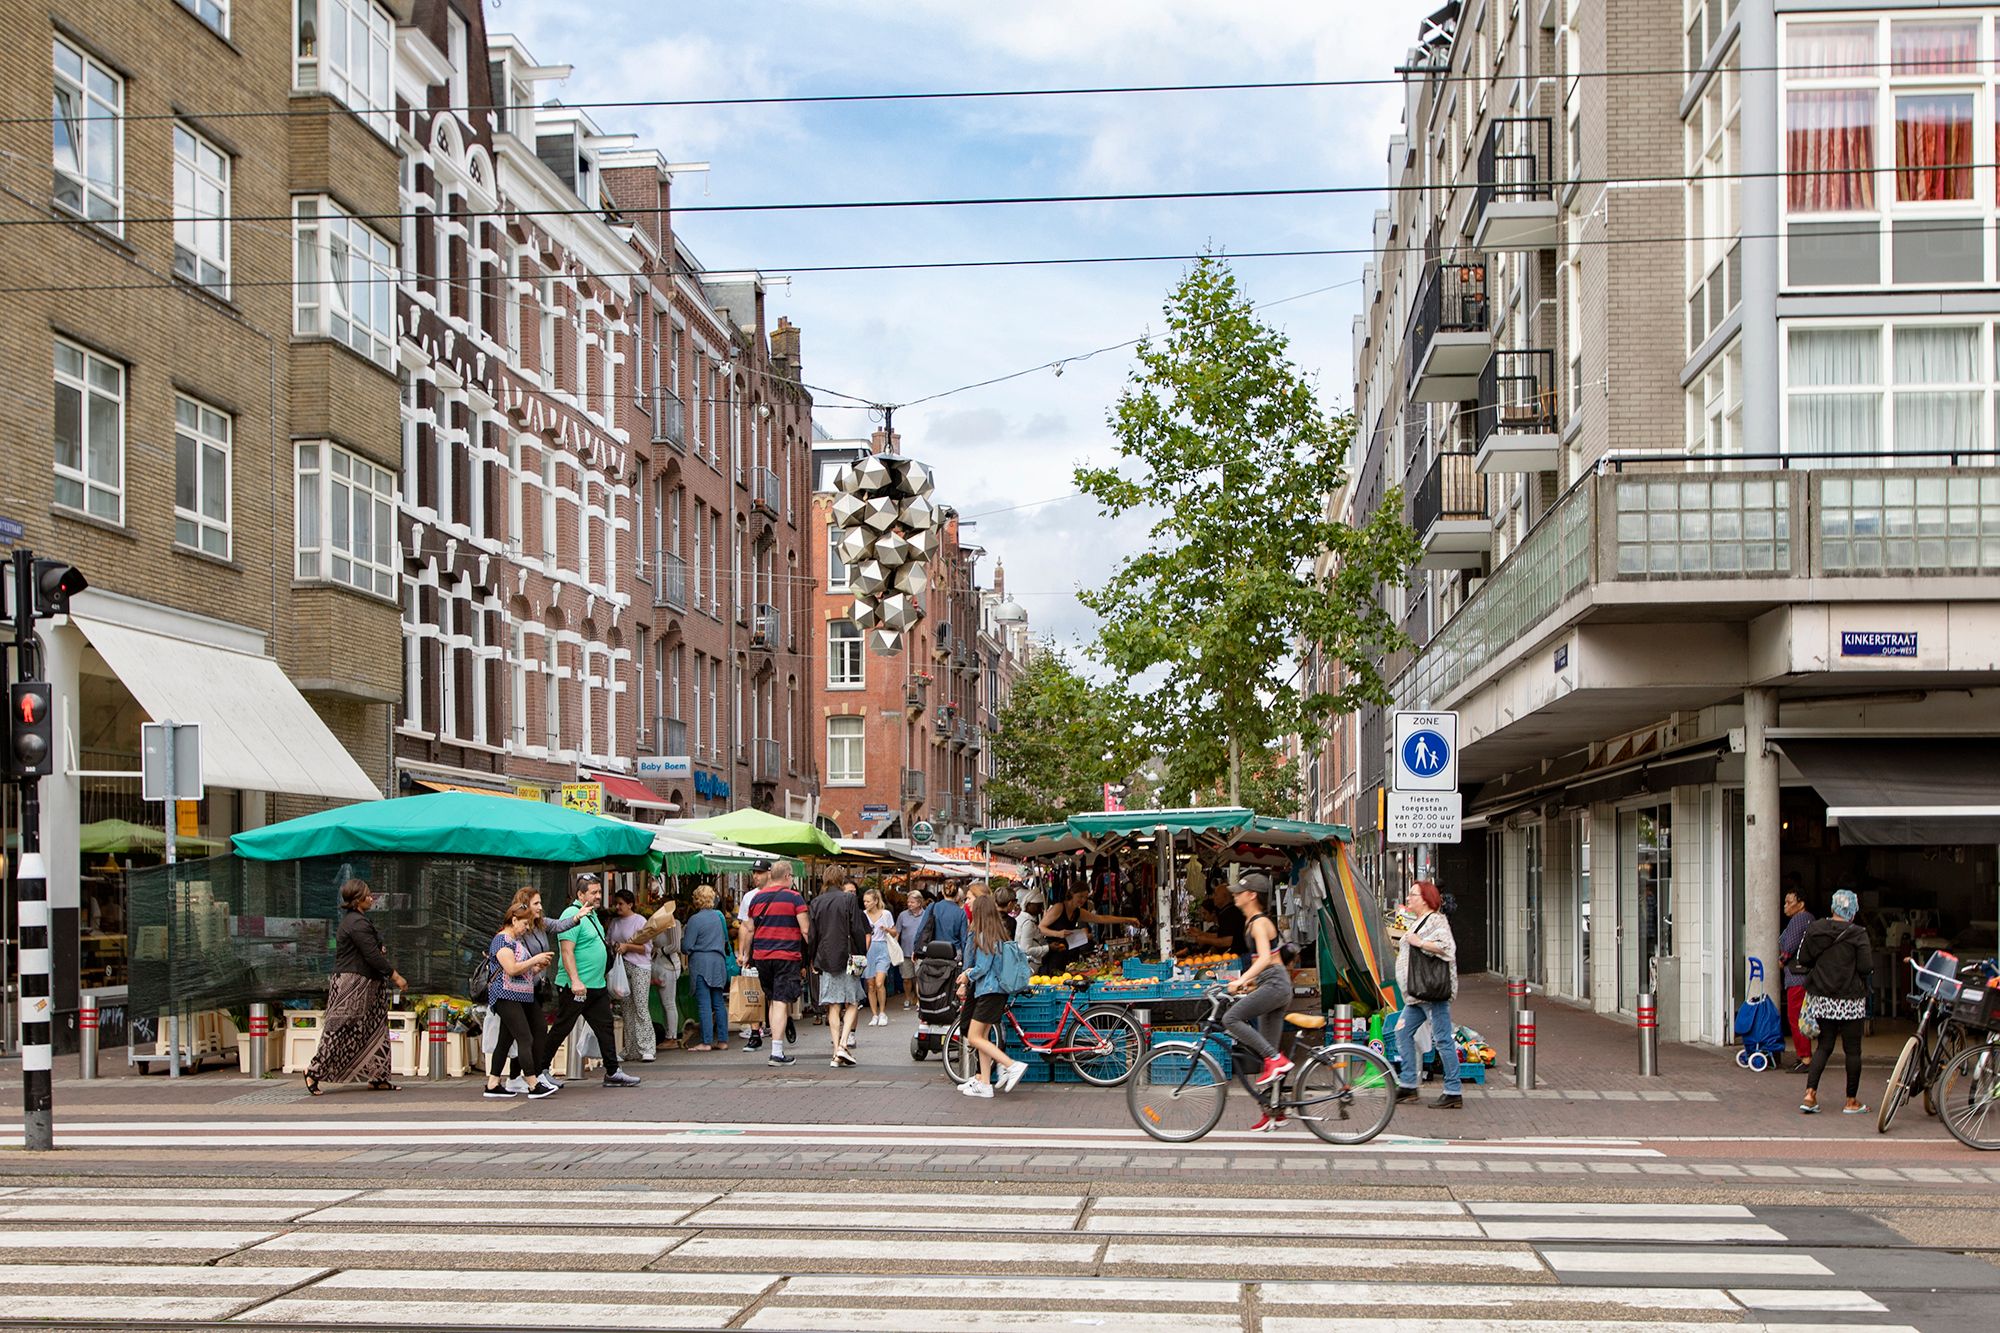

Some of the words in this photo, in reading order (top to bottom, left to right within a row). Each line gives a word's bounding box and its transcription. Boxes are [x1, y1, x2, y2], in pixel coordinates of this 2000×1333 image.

[1845, 634, 1916, 646] KINKERSTRAAT
[1882, 647, 1915, 655] OUD-WEST
[1413, 717, 1439, 725] ZONE
[641, 762, 661, 772] Baby
[665, 762, 686, 770] Boem
[1401, 805, 1448, 813] toegestaan
